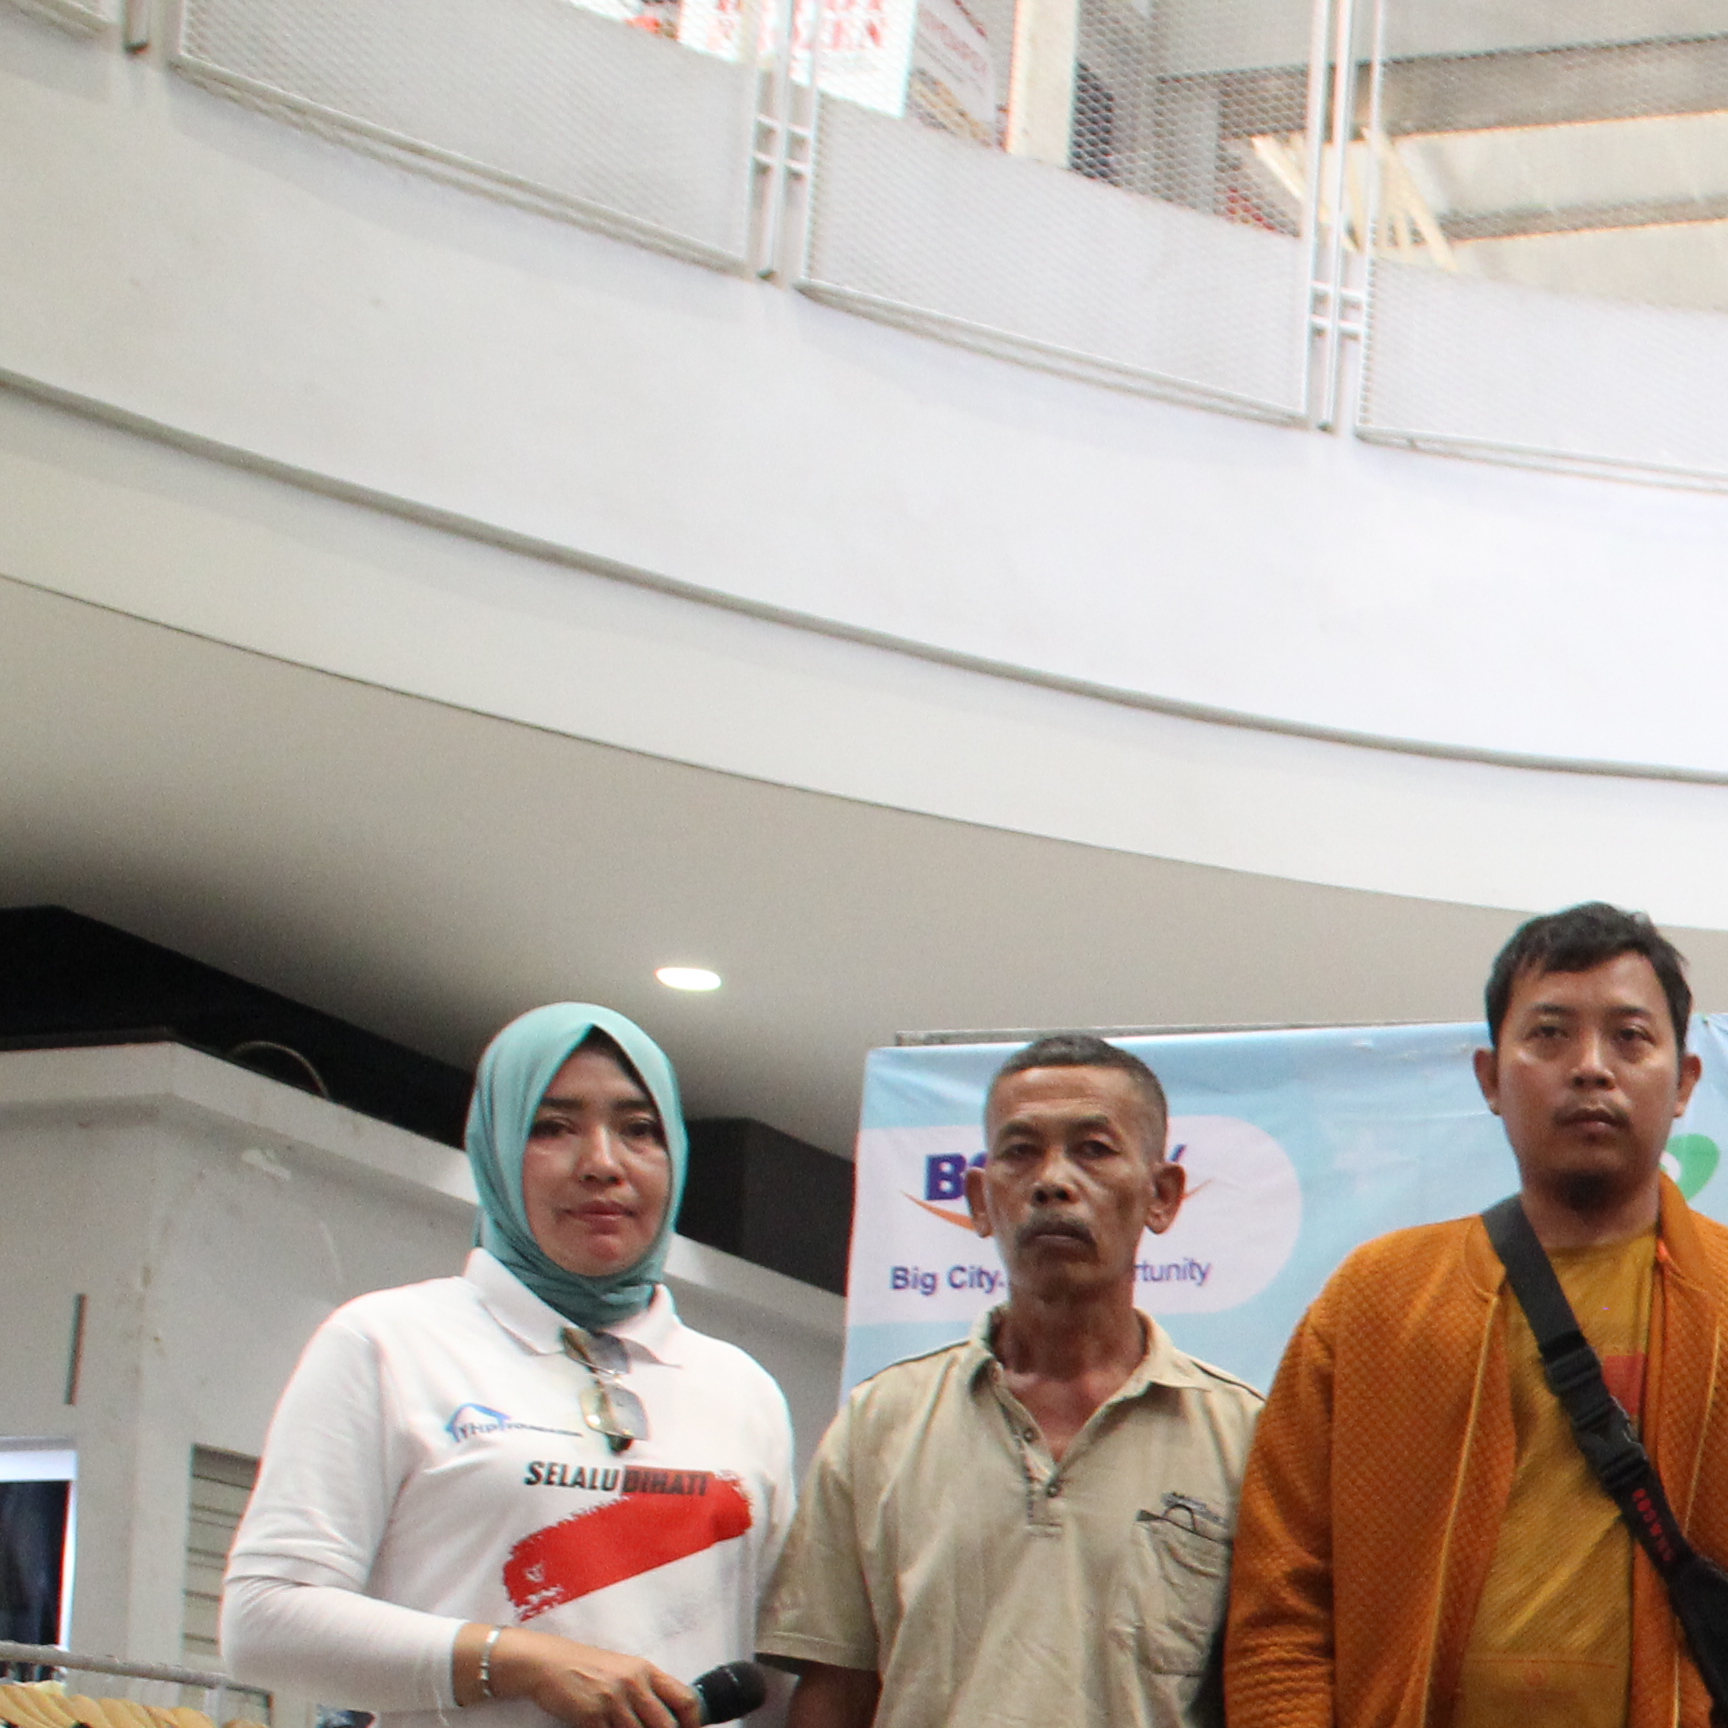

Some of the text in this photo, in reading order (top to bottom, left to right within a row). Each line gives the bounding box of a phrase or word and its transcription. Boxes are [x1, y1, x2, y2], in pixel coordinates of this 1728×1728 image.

[889, 1266, 937, 1297] Big
[523, 1460, 708, 1496] SELALU DIHATI
